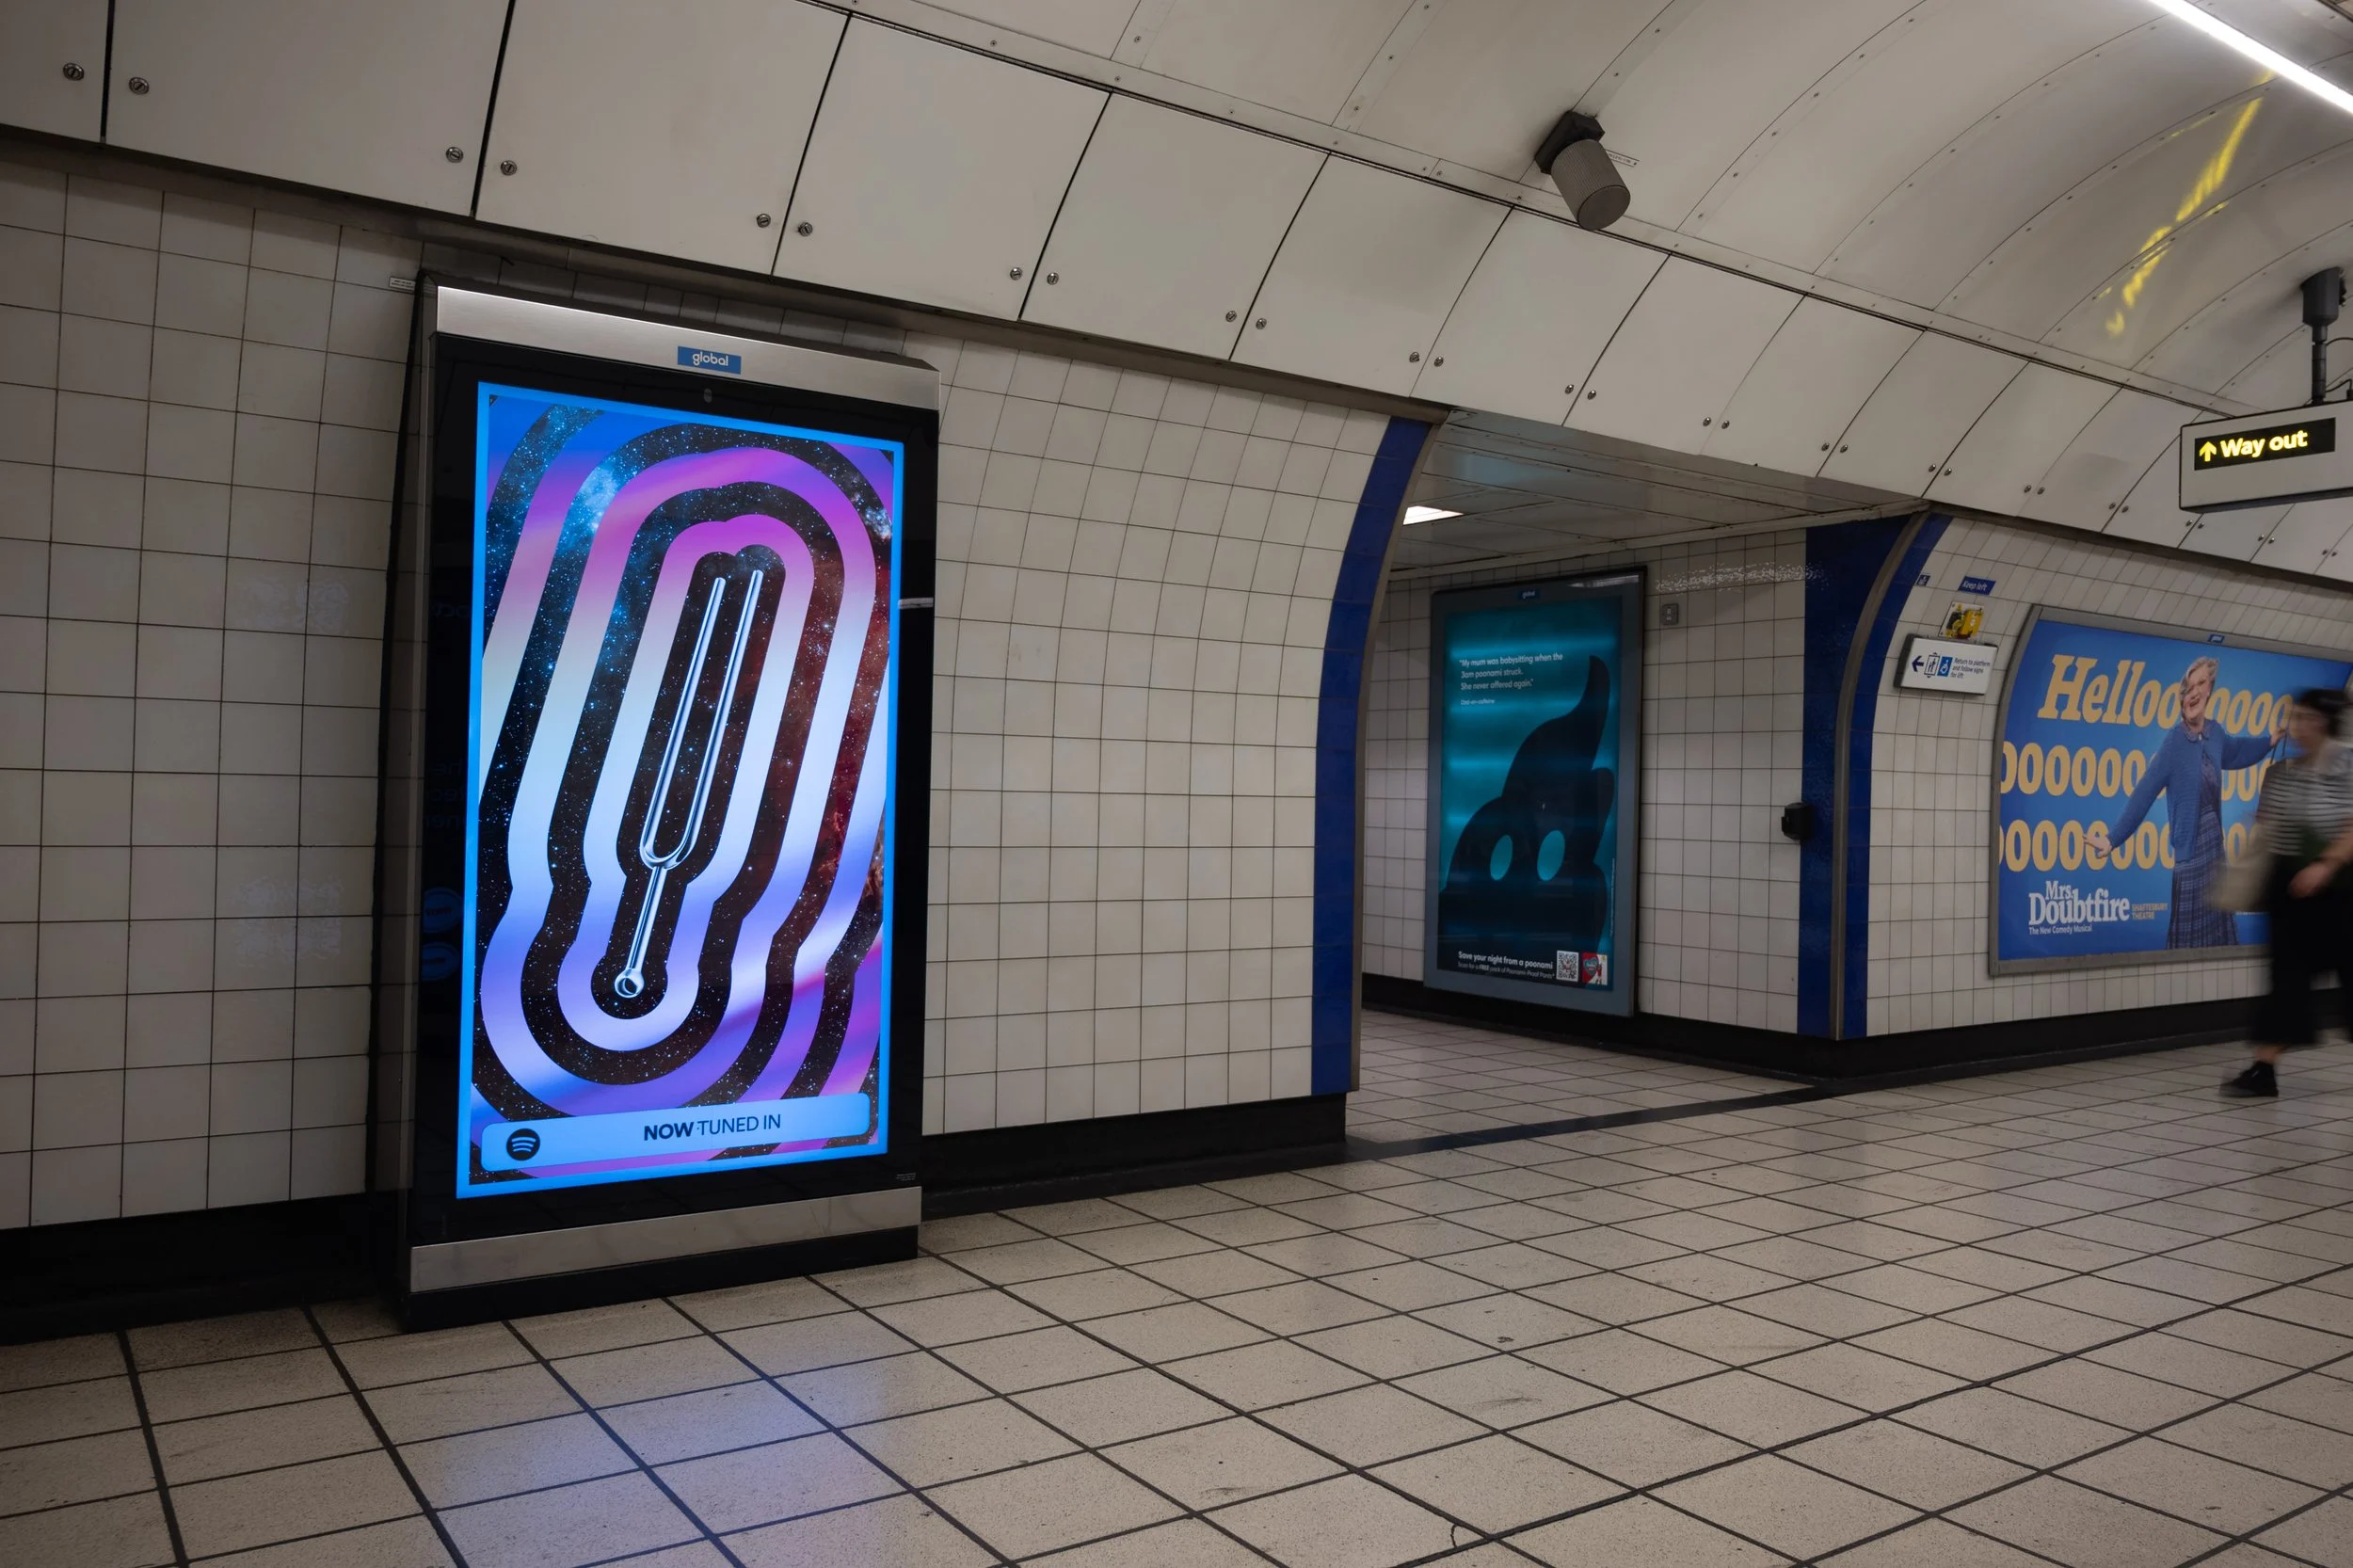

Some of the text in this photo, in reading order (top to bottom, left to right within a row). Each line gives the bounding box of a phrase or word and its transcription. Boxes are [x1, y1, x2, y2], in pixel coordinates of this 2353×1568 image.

[692, 351, 728, 366] global
[2219, 430, 2308, 458] Way out
[1500, 655, 1533, 664] babysitting
[1553, 652, 1563, 661] the
[1461, 670, 1474, 679] 3am
[1475, 669, 1502, 679] poonami
[1490, 680, 1513, 689] offered
[2028, 888, 2130, 925] Doubtfire
[2028, 926, 2040, 935] The
[2052, 925, 2073, 935] Comedy
[2073, 923, 2093, 933] Musical
[1458, 951, 1473, 960] Save
[1487, 954, 1503, 965] night
[1503, 956, 1518, 965] from
[1525, 960, 1553, 969] poonami
[644, 1113, 781, 1141] NOW TUNED IN
